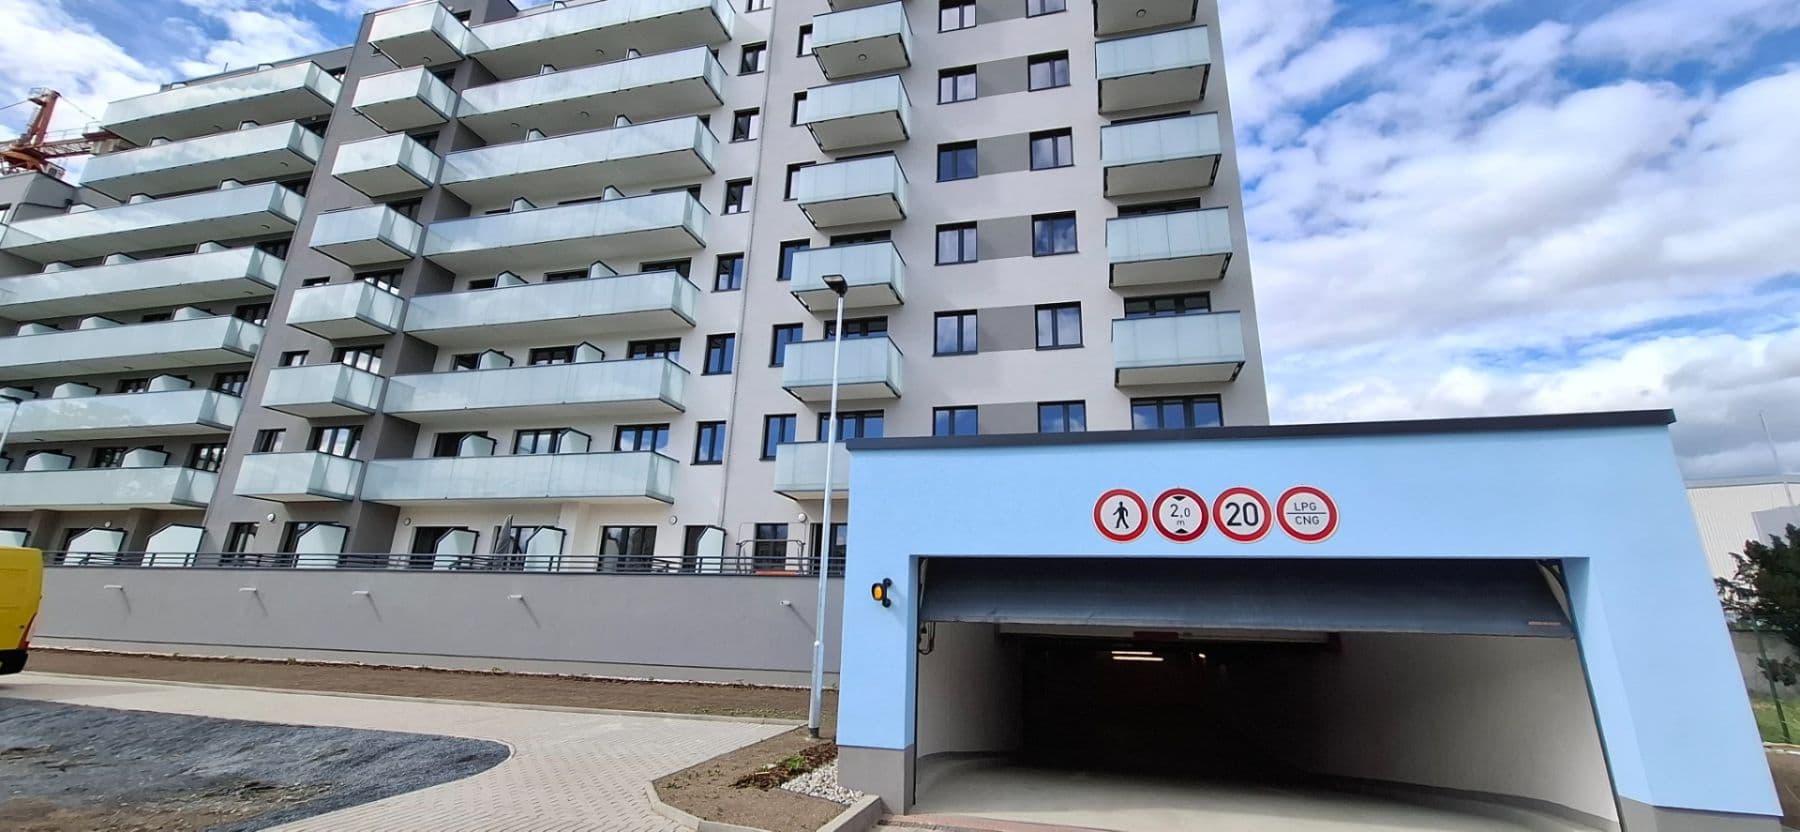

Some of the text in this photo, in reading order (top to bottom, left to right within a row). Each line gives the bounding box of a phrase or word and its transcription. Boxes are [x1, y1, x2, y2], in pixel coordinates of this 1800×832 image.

[1294, 502, 1317, 511] LPG
[1225, 501, 1259, 527] 20
[1295, 516, 1320, 525] CNG
